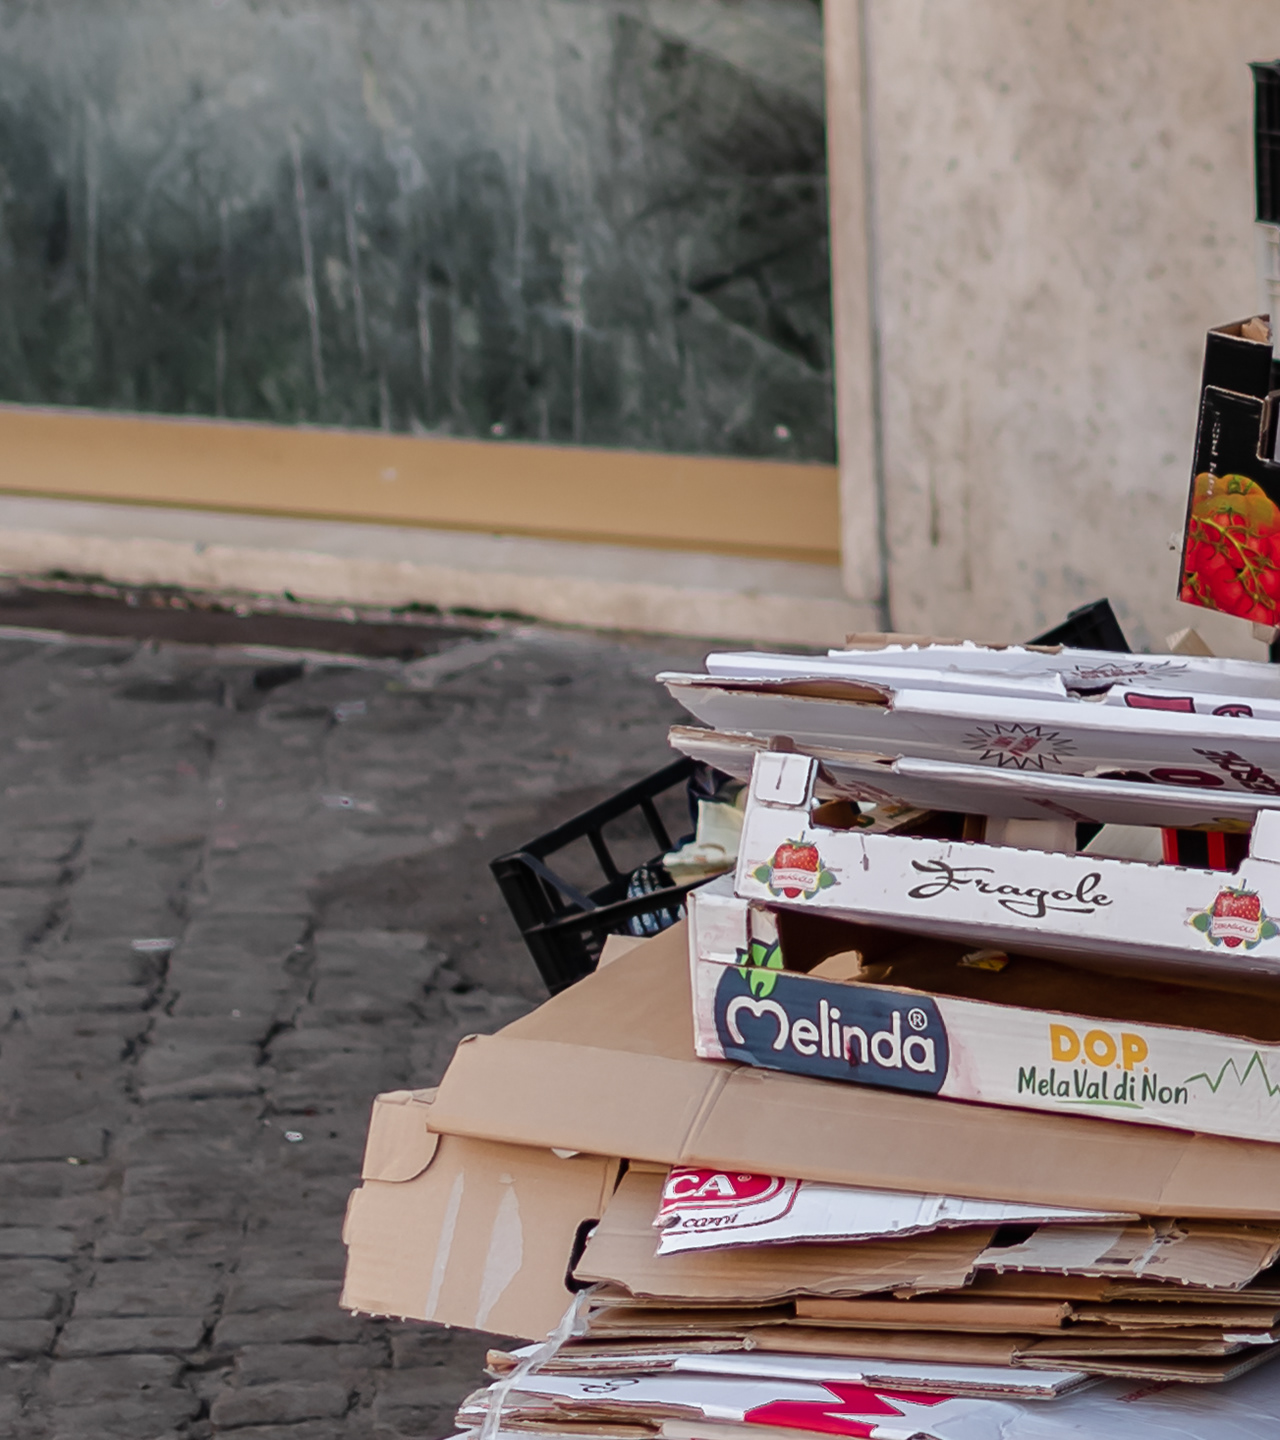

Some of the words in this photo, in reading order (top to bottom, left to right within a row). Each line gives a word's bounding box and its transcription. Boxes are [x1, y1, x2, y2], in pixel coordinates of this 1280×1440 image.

[907, 857, 1115, 919] Fragole
[726, 994, 937, 1074] Melinda
[1049, 1023, 1150, 1074] D.O.P.
[1141, 1072, 1189, 1106] Non
